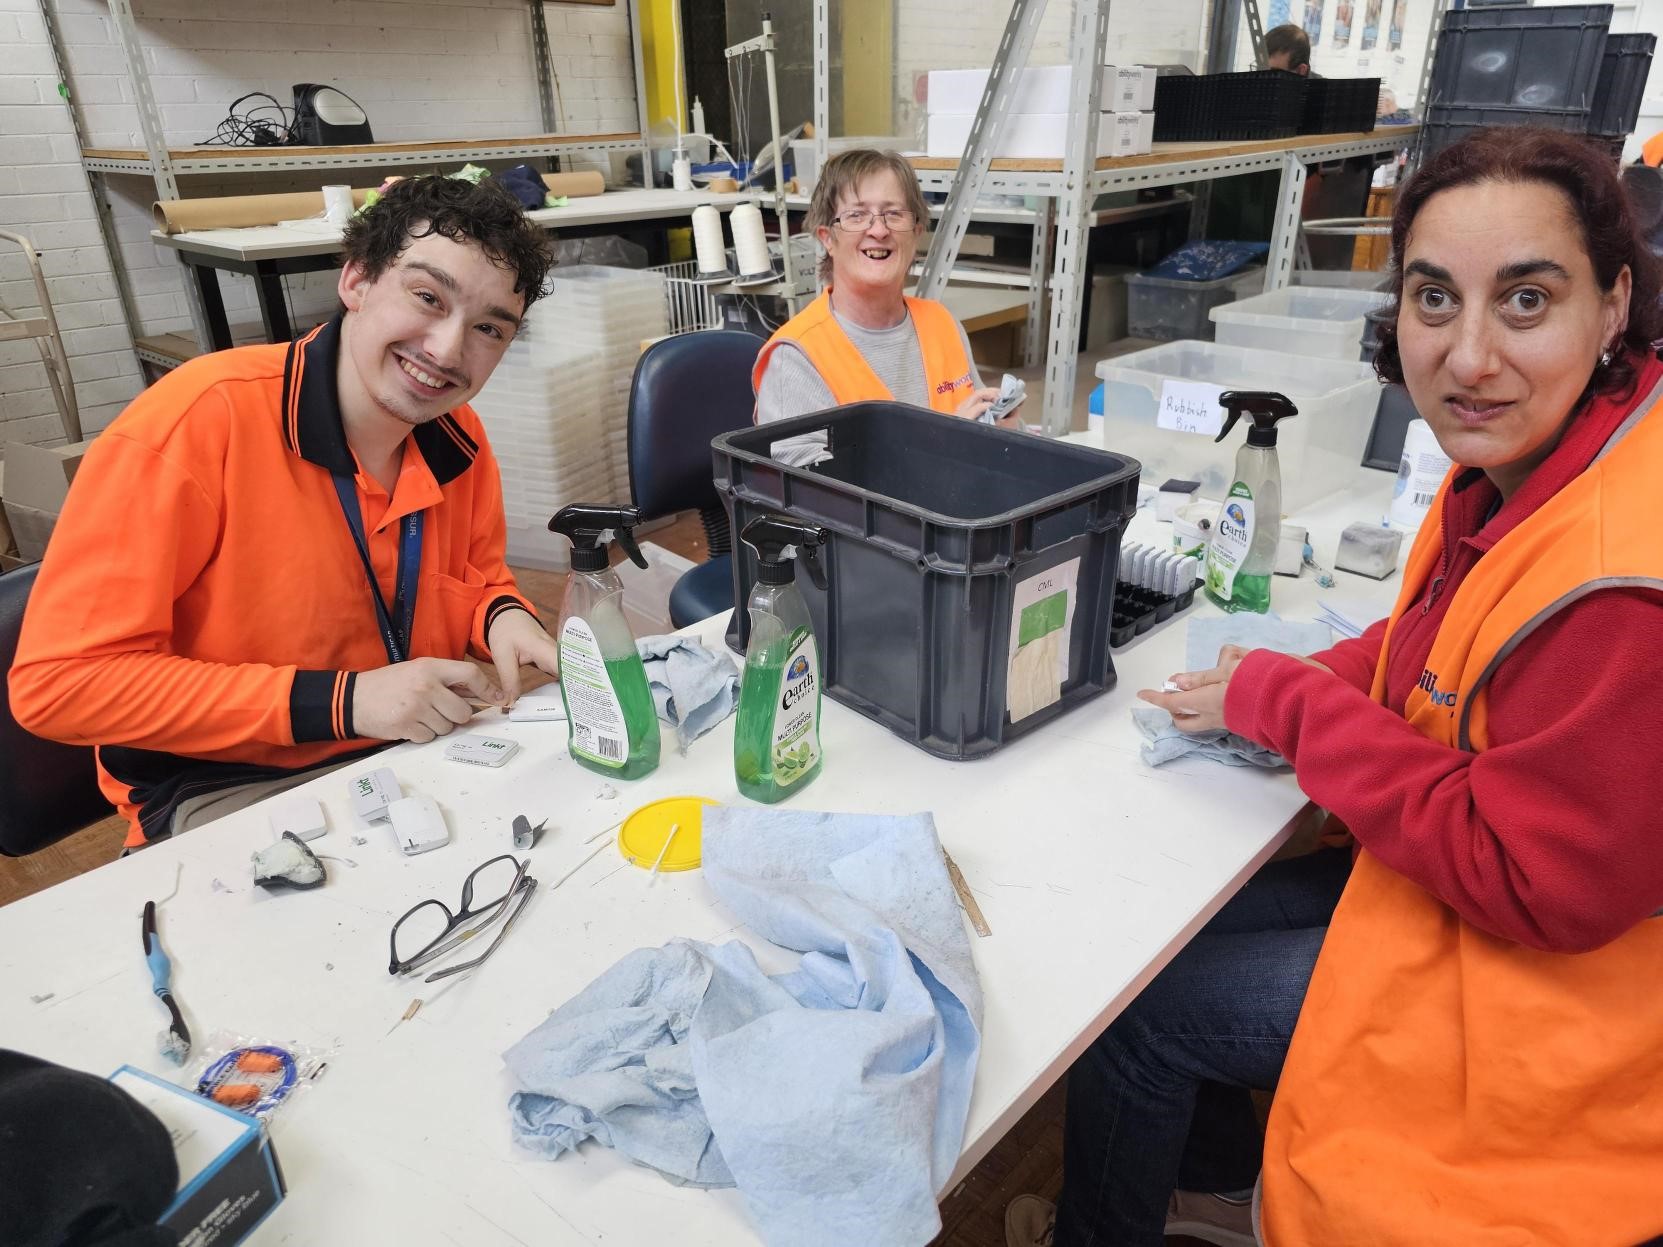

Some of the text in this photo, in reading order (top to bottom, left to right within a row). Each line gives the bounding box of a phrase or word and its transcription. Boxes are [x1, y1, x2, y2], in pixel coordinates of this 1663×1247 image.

[936, 372, 974, 395] abilitywor
[409, 510, 417, 538] SSUR.
[1220, 520, 1247, 542] earth
[782, 672, 814, 711] earth
[793, 685, 815, 704] choice
[777, 727, 793, 741] MULTI
[792, 712, 812, 731] PURPOSE
